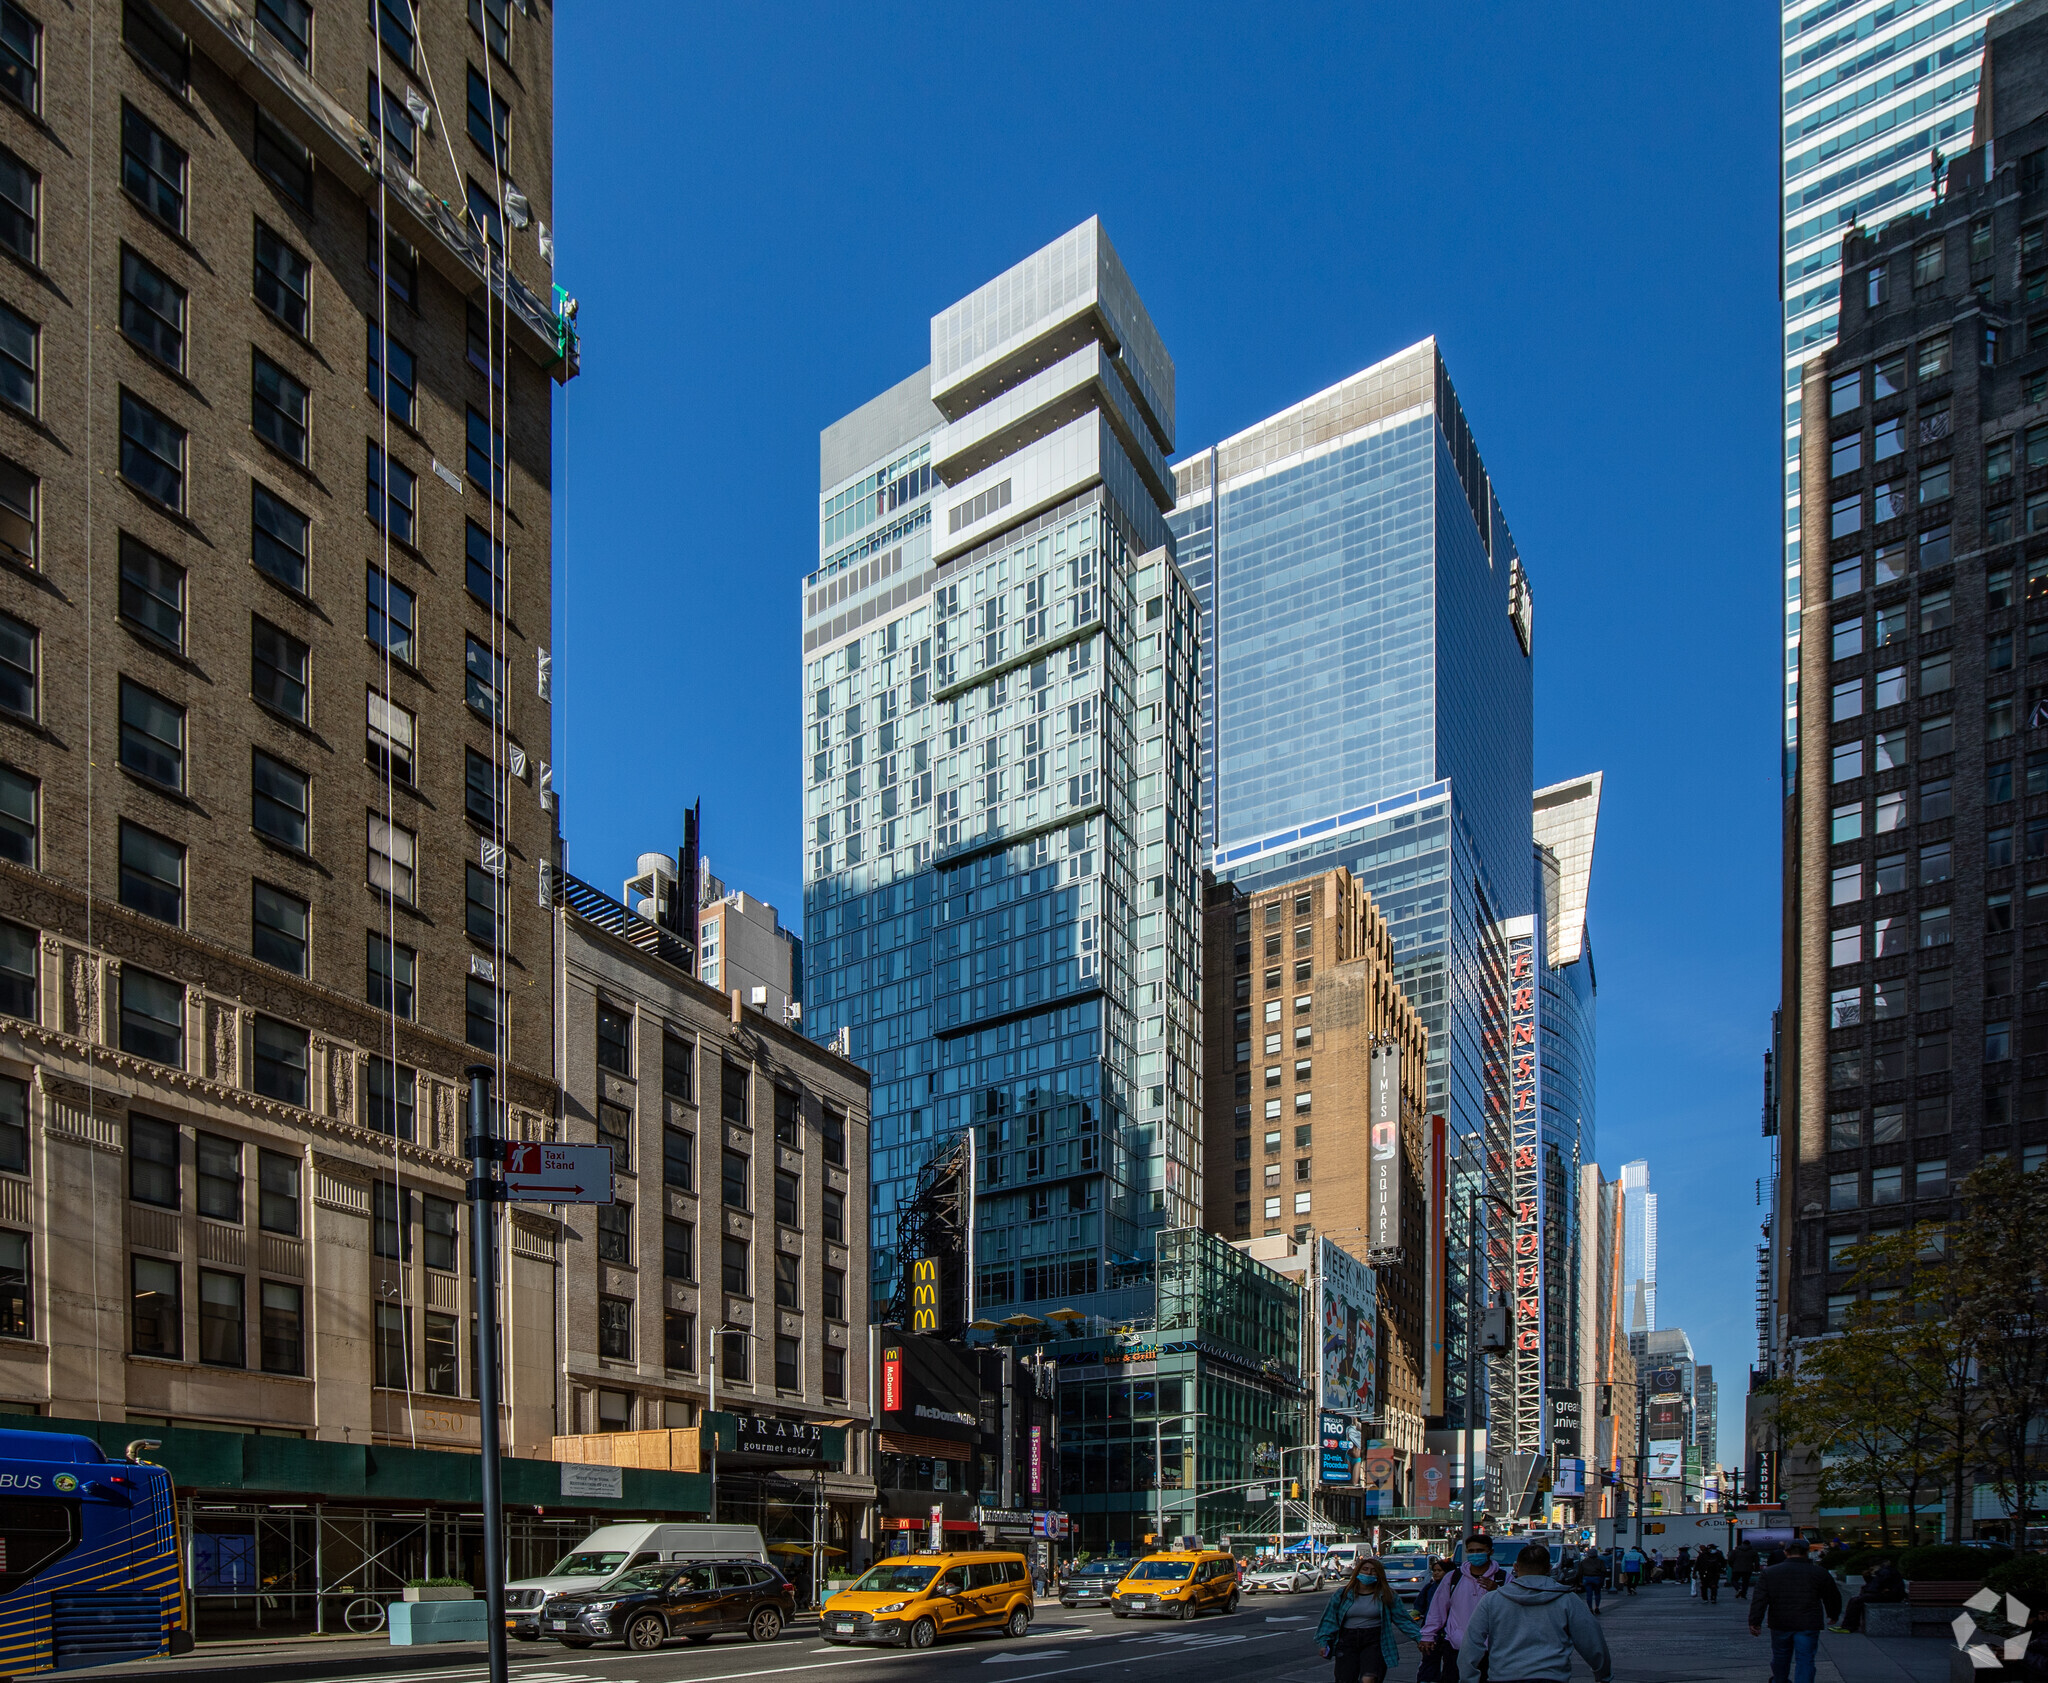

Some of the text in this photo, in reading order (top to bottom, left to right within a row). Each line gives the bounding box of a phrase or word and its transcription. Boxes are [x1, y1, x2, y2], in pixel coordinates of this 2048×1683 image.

[1380, 1052, 1388, 1118] TIMES
[544, 1150, 565, 1160] Taxi
[1514, 953, 1538, 1350] ERNST & YOUNG
[544, 1160, 575, 1170] Stand
[1379, 1165, 1388, 1243] SQUARE
[1324, 1244, 1376, 1296] MEEK MILL
[1104, 1352, 1156, 1364] Bar & Grill
[424, 1410, 464, 1433] 550
[915, 1404, 976, 1426] McDonald's
[738, 1417, 821, 1440] FRAME
[1323, 1422, 1344, 1435] neo
[744, 1441, 816, 1457] gourmet eatery
[1031, 1438, 1039, 1466] MIDTOWN
[1323, 1460, 1349, 1470] Procedure
[1760, 1452, 1769, 1482] YARD
[0, 1473, 42, 1490] BUS
[1031, 1467, 1039, 1491] COMICS
